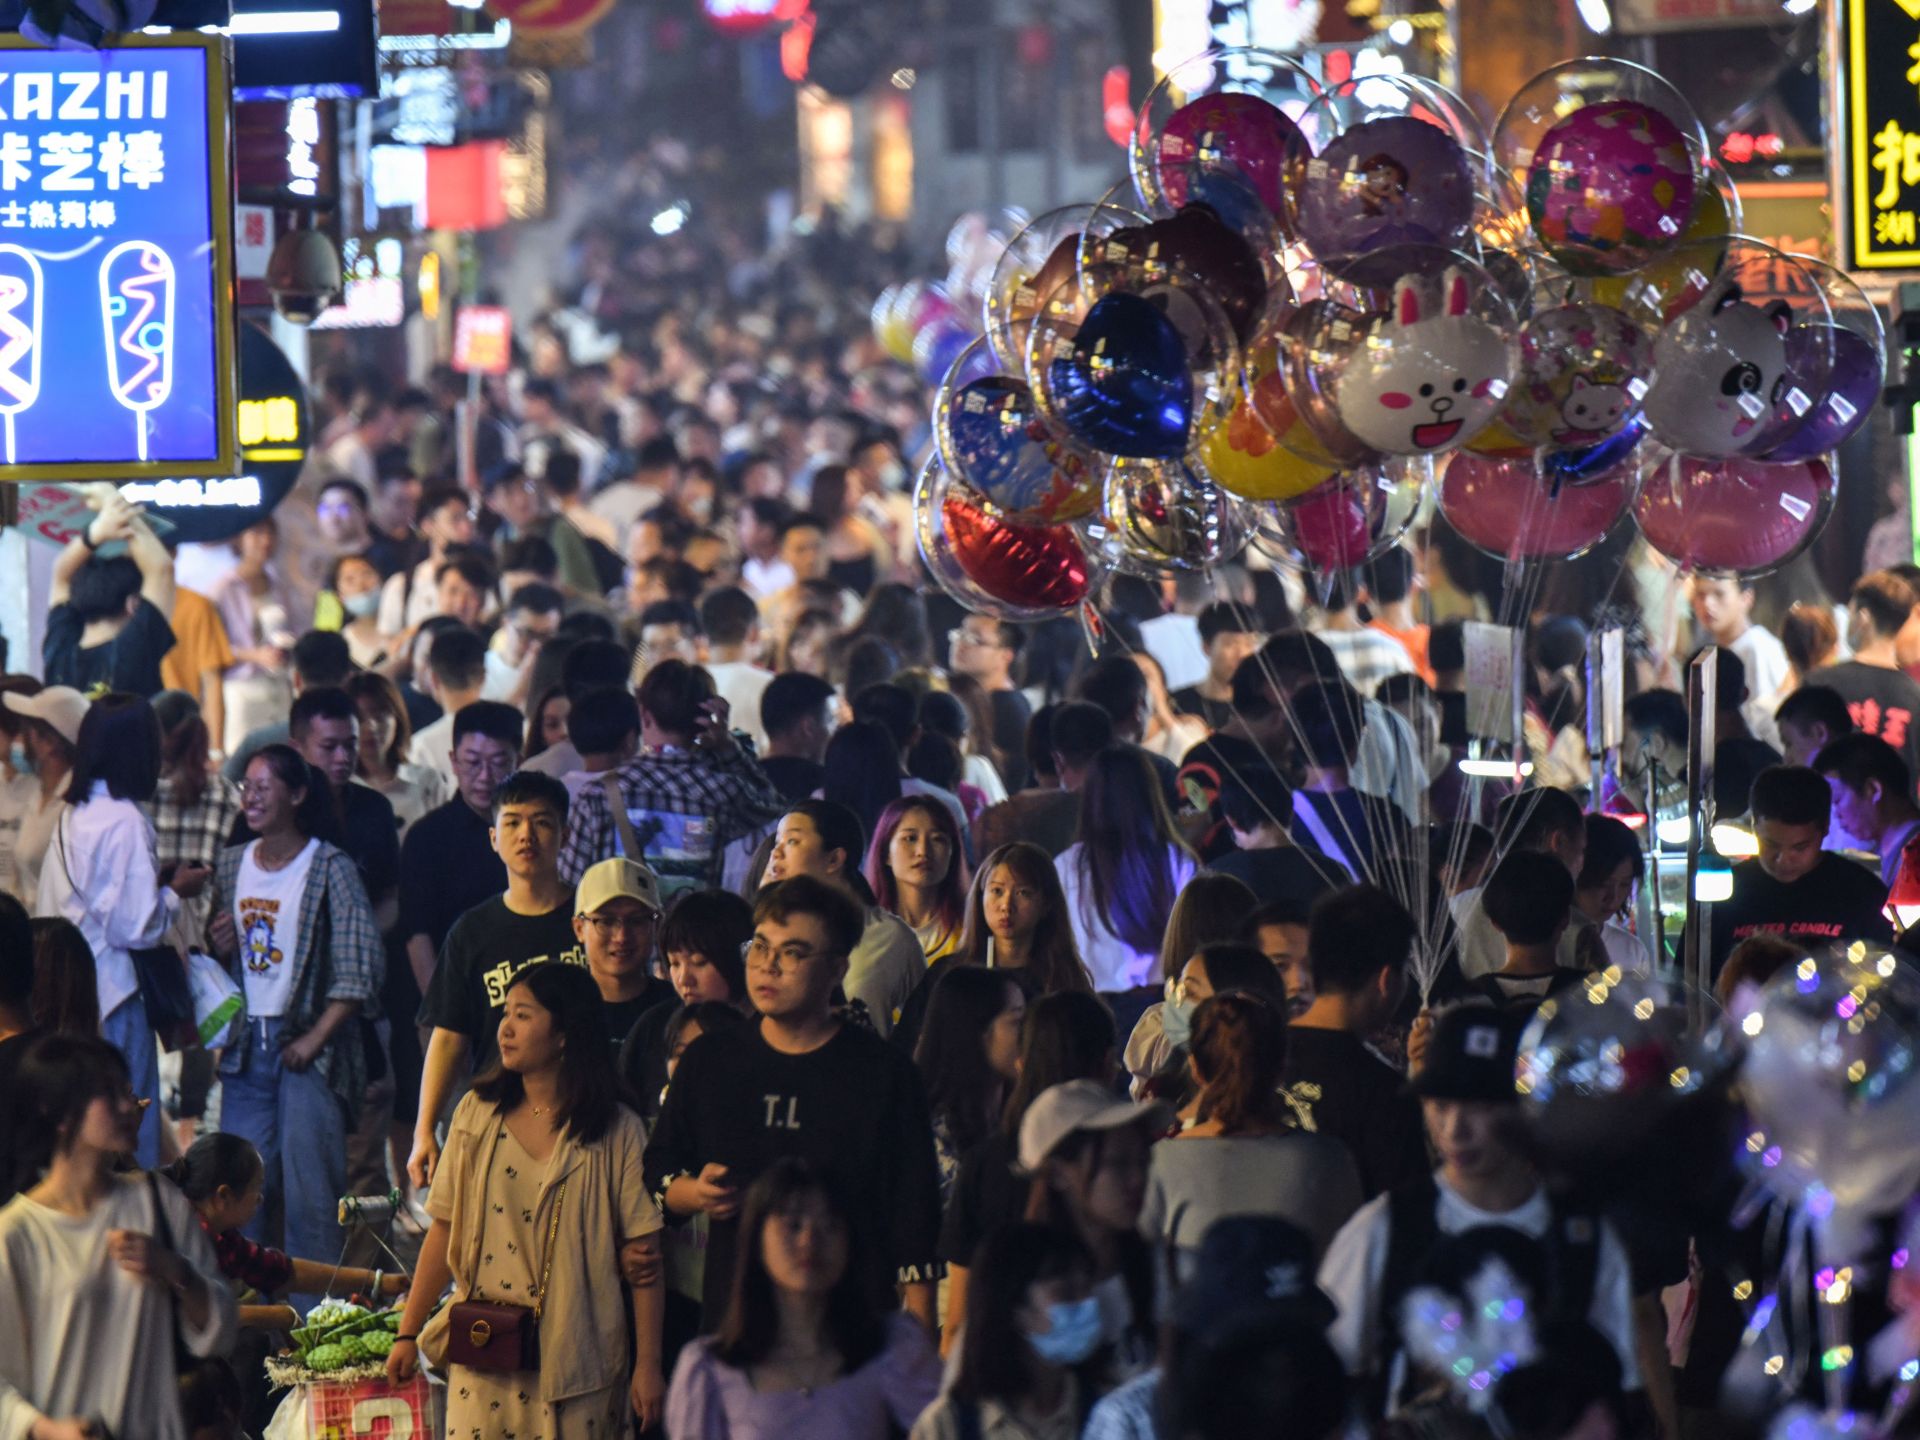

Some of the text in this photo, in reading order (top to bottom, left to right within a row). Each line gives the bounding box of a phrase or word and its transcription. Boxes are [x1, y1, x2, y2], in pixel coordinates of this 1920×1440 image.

[0, 70, 168, 120] AZHI
[1873, 211, 1920, 245] 湖
[1789, 921, 1843, 937] CANDLE
[764, 1094, 800, 1129] T.L
